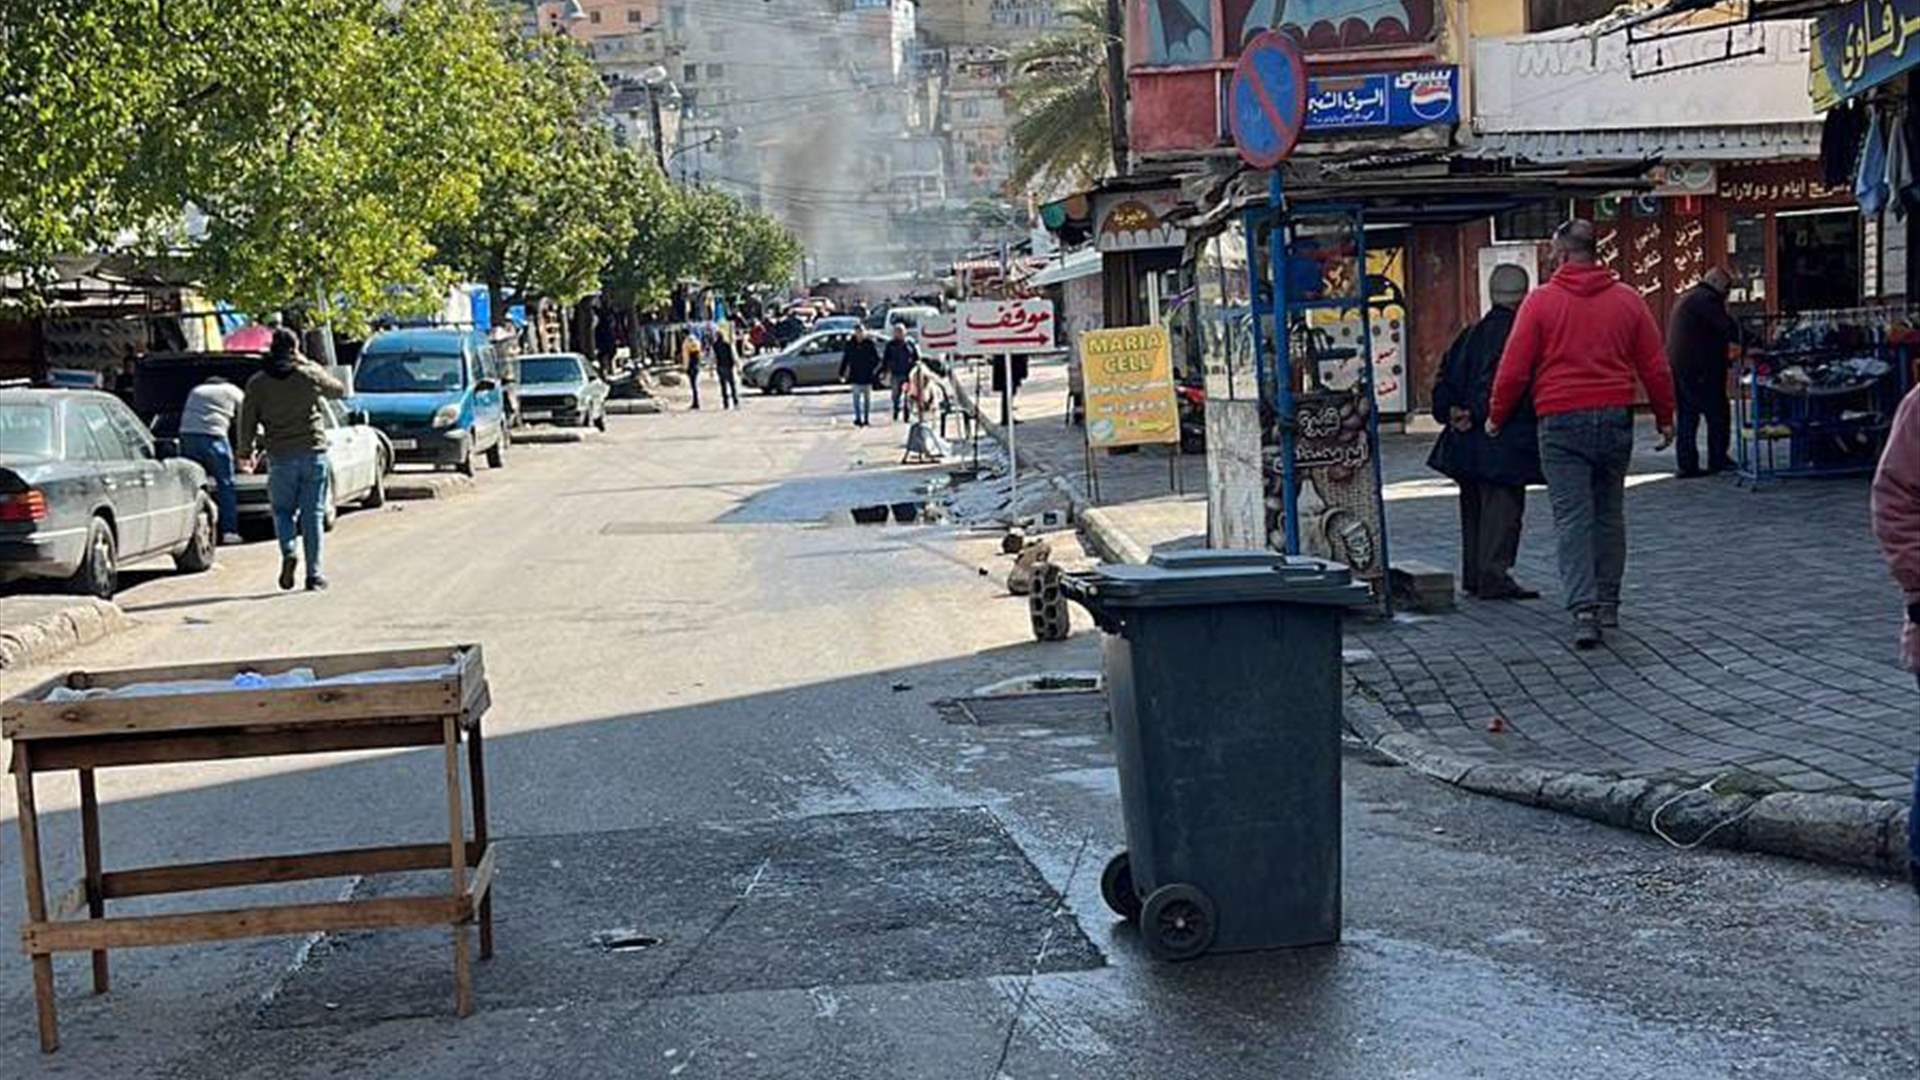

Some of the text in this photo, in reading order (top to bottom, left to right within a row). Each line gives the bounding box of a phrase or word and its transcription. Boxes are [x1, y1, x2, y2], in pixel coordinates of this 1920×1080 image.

[1344, 88, 1383, 111] السوق
[1770, 184, 1779, 199] و
[966, 302, 1051, 334] موقف
[1088, 334, 1163, 355] MARIA
[1104, 354, 1151, 375] CELL
